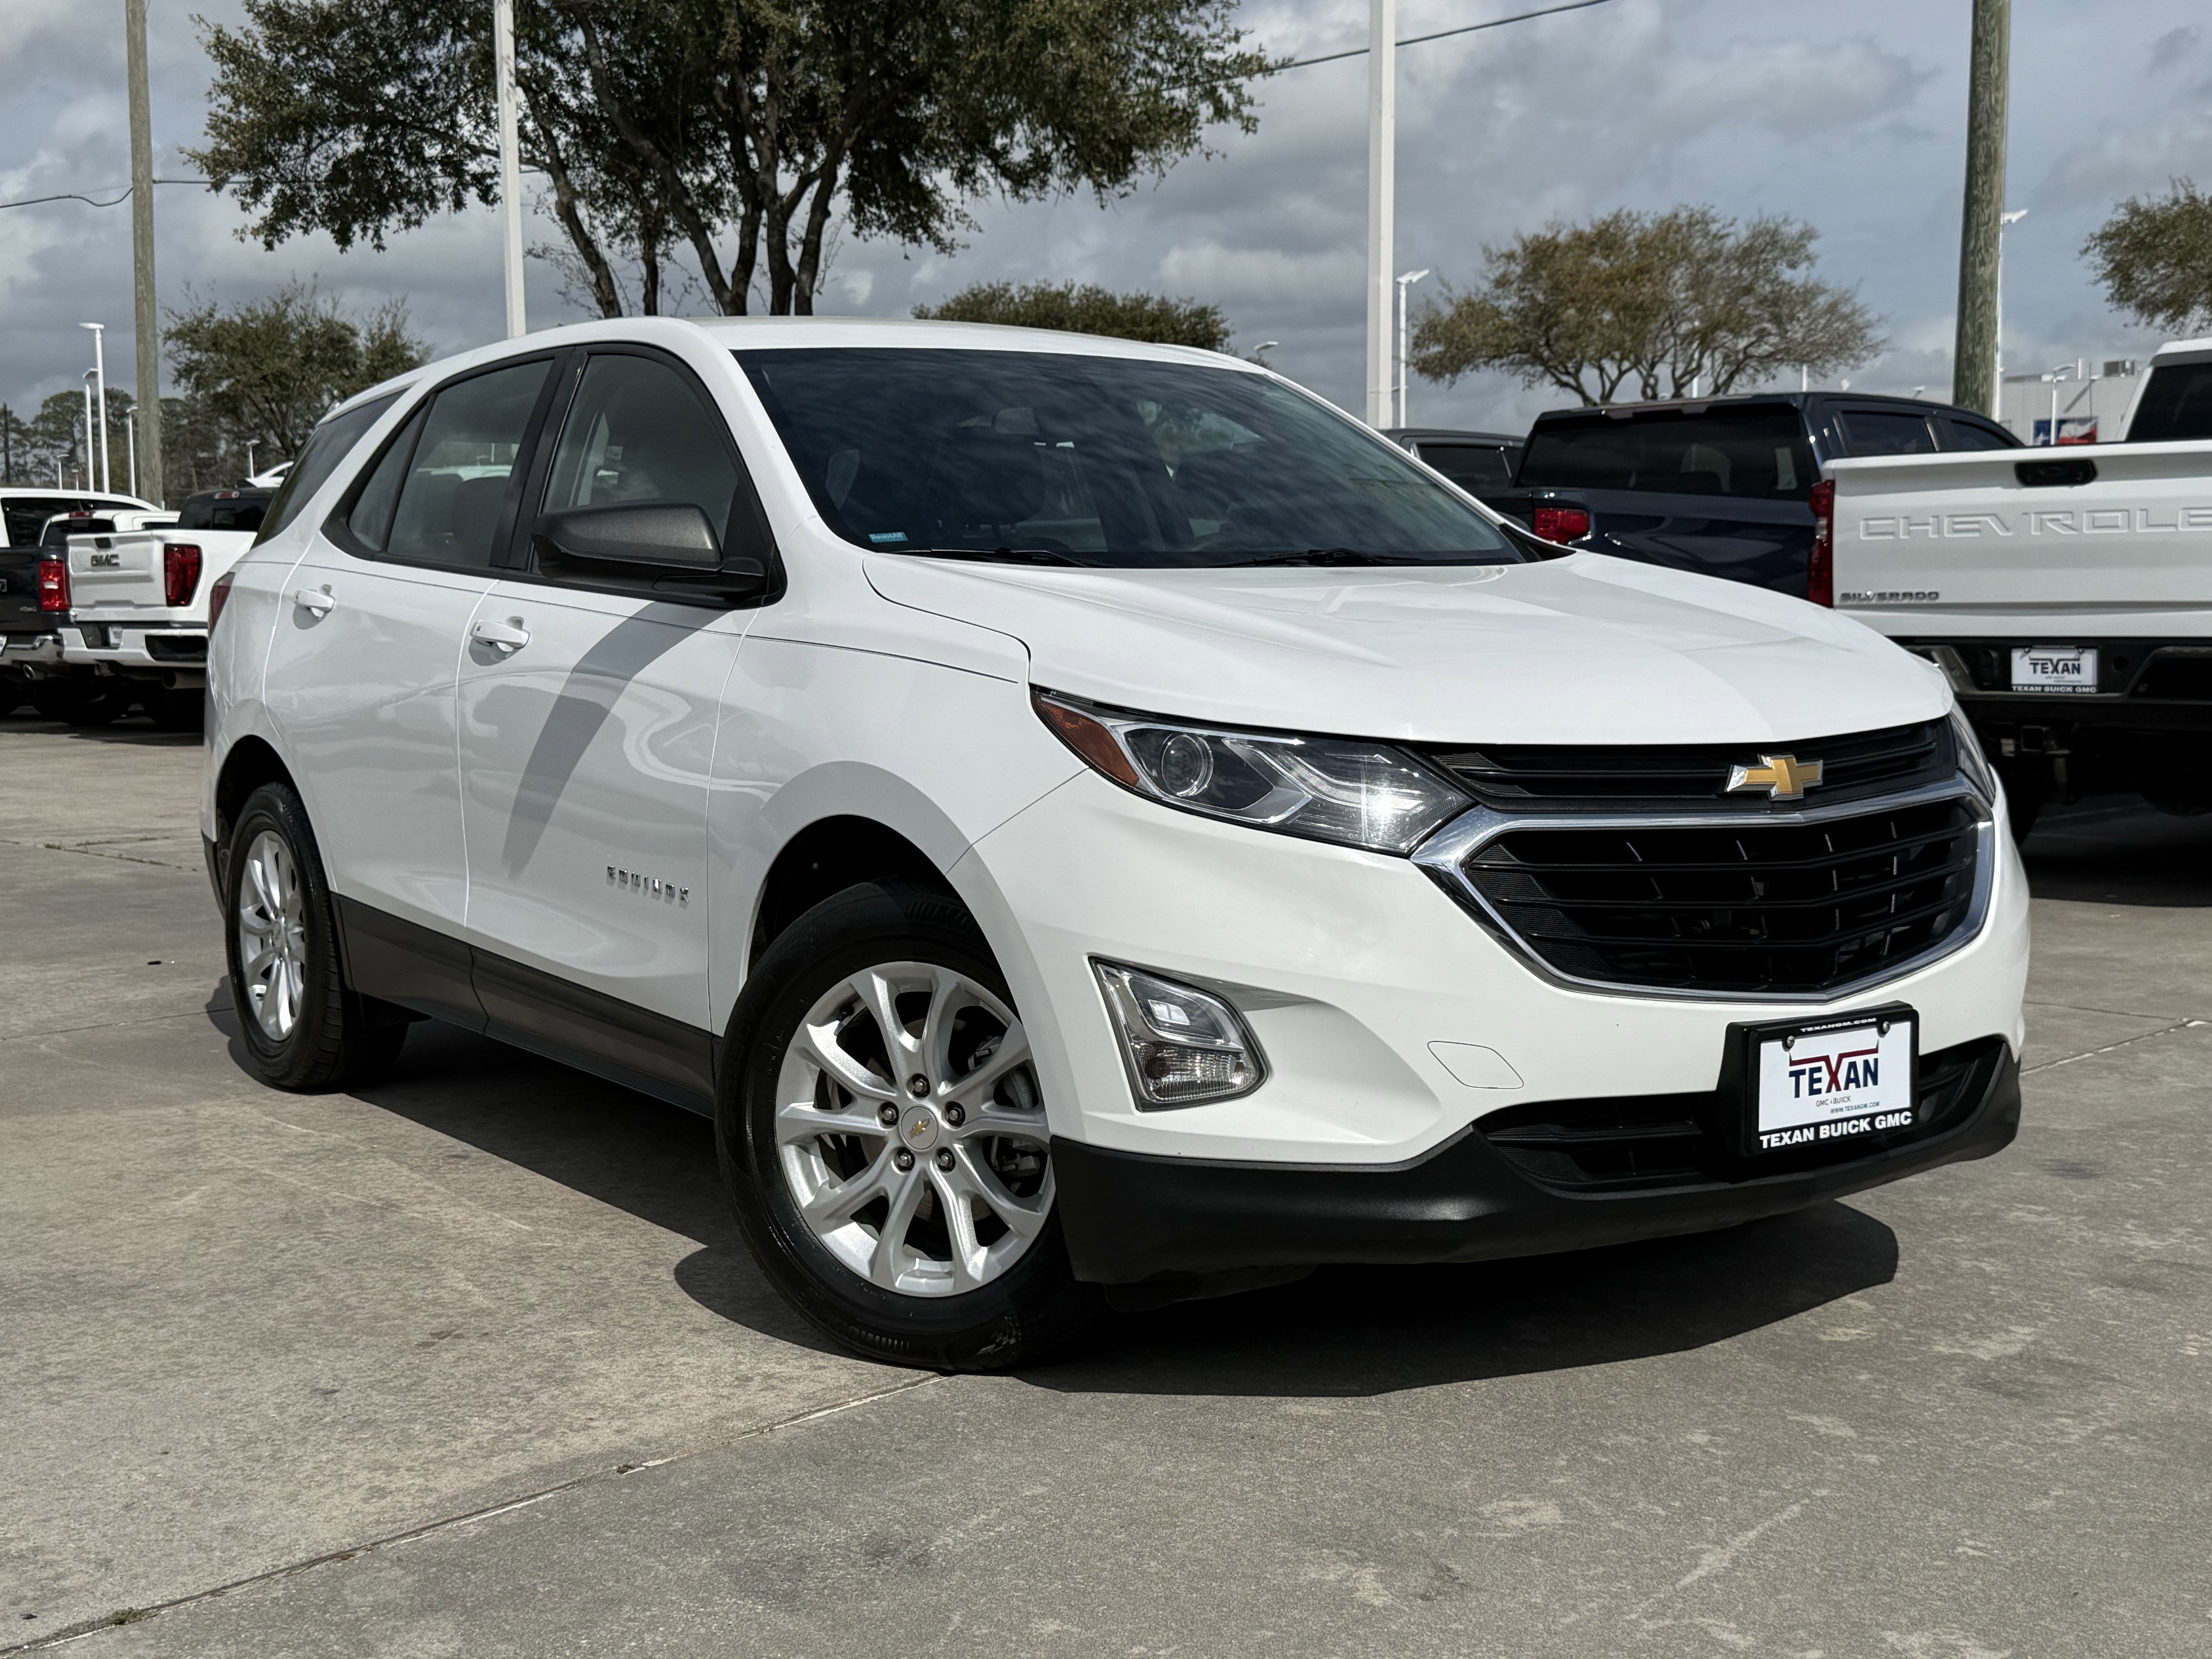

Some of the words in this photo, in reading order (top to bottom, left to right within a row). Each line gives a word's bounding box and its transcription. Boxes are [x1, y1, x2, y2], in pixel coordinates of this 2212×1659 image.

[91, 554, 120, 567] GMC
[1840, 591, 1939, 601] SILVERADO
[2029, 659, 2081, 674] TEXAN
[607, 865, 689, 903] EQUINOX
[1800, 1017, 1877, 1032] TEXANGM.COM
[1788, 1046, 1879, 1099] TEXAN
[1816, 1099, 1829, 1107] GMC
[1833, 1096, 1851, 1104] BUICK
[1759, 1127, 1815, 1149] TEXAN
[1819, 1117, 1872, 1139] BUICK
[1874, 1111, 1913, 1130] GMC
